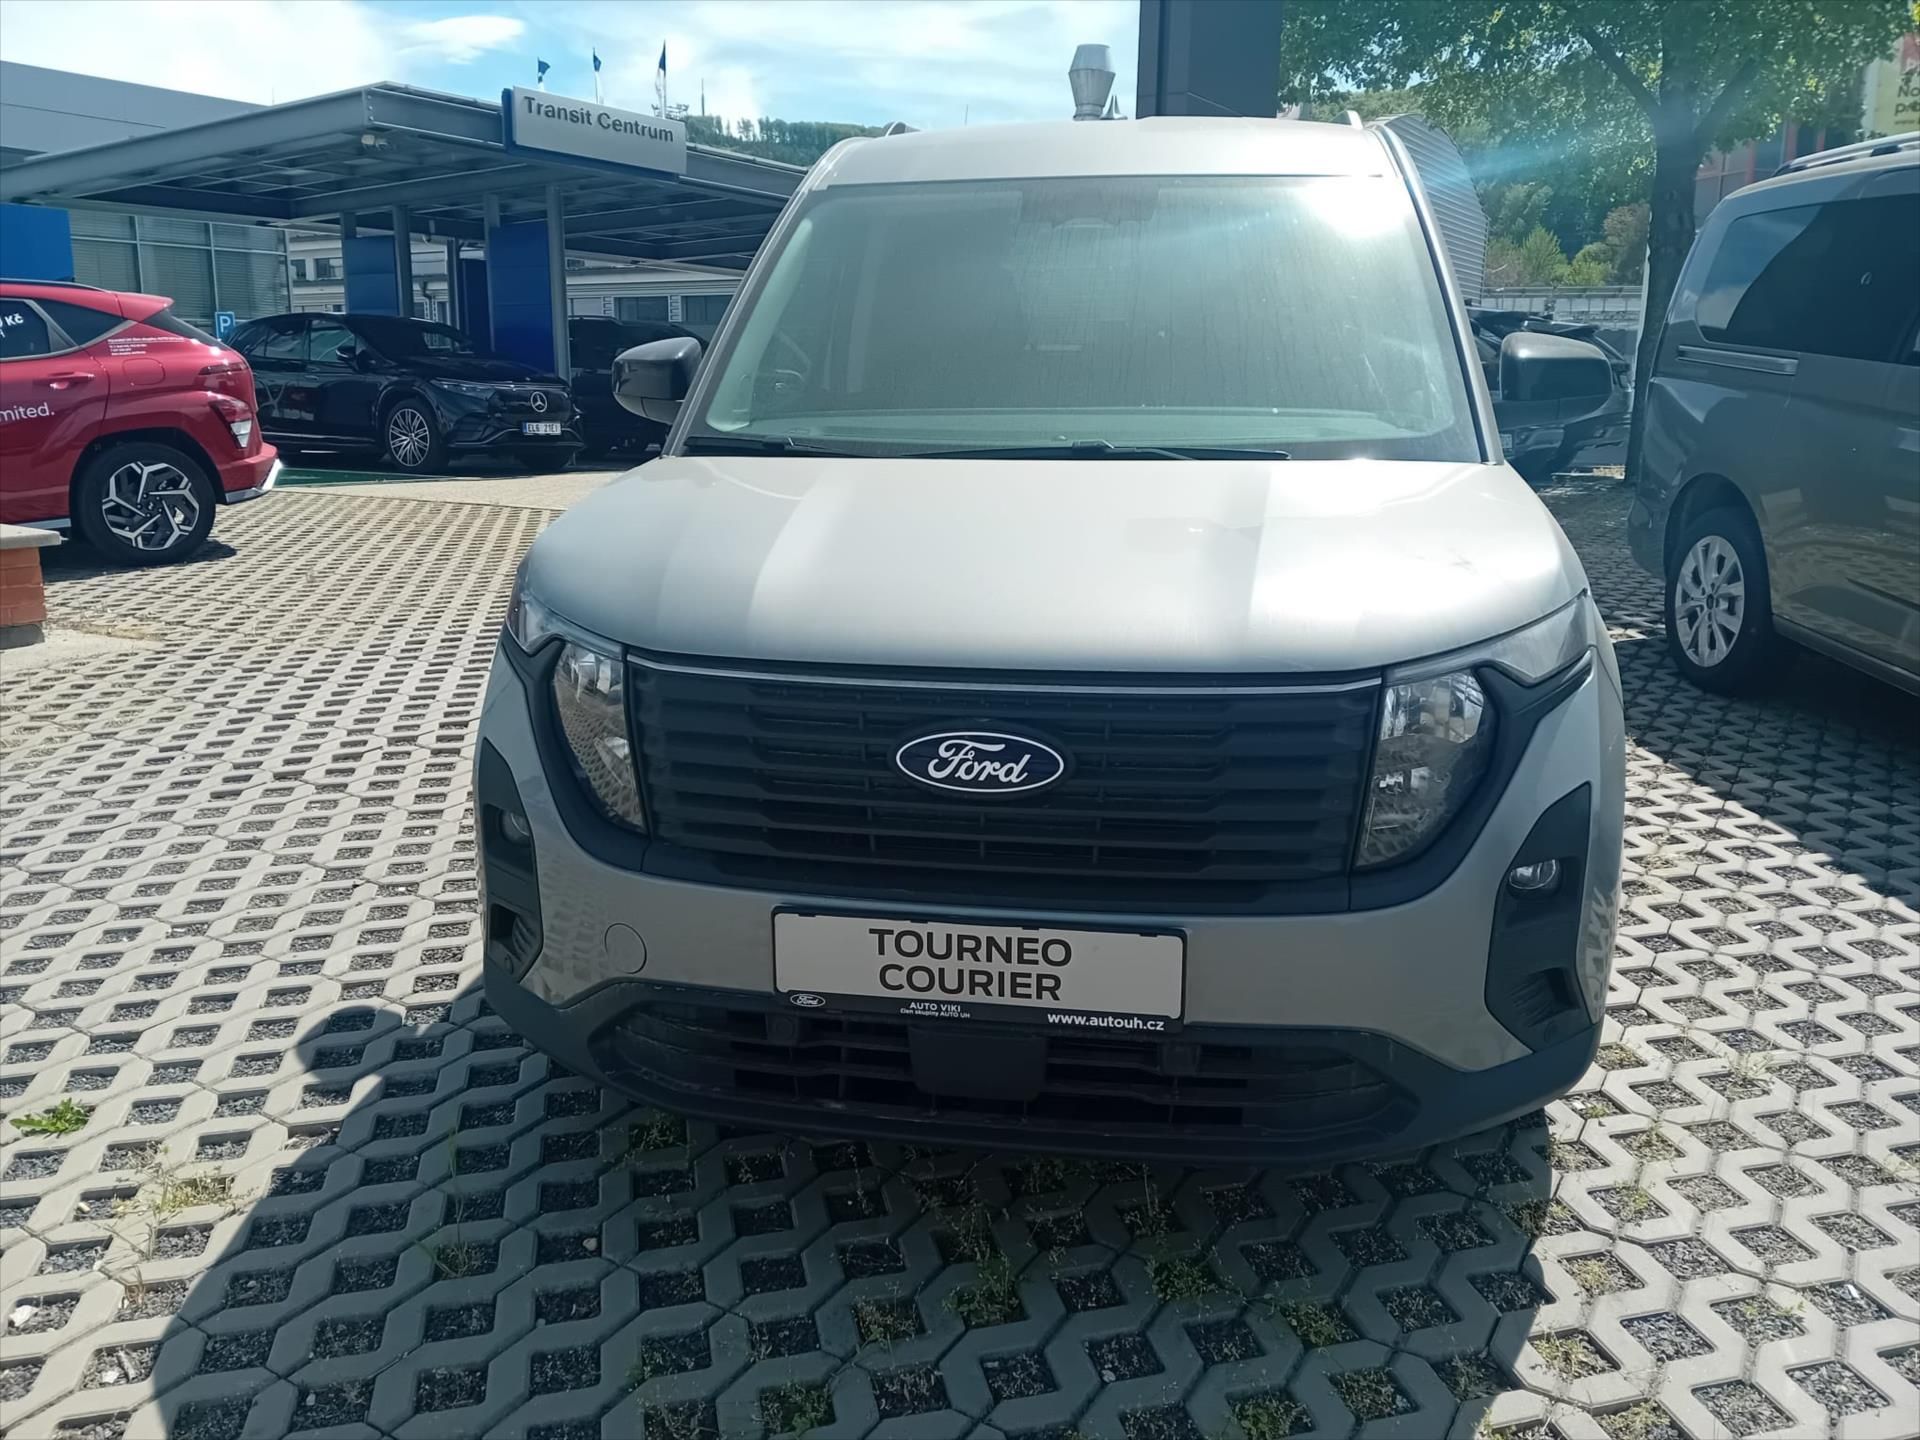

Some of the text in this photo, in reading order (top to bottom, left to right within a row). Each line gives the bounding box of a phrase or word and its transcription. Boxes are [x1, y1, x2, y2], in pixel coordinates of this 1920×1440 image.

[524, 96, 674, 142] Transit Centrum
[220, 315, 231, 333] P
[927, 739, 1032, 783] Ford
[868, 928, 1073, 967] TOURNEO
[879, 963, 1062, 1001] COURIER
[909, 1002, 960, 1012] AUTO VIKI
[1047, 1012, 1165, 1031] www.autouh.cz
